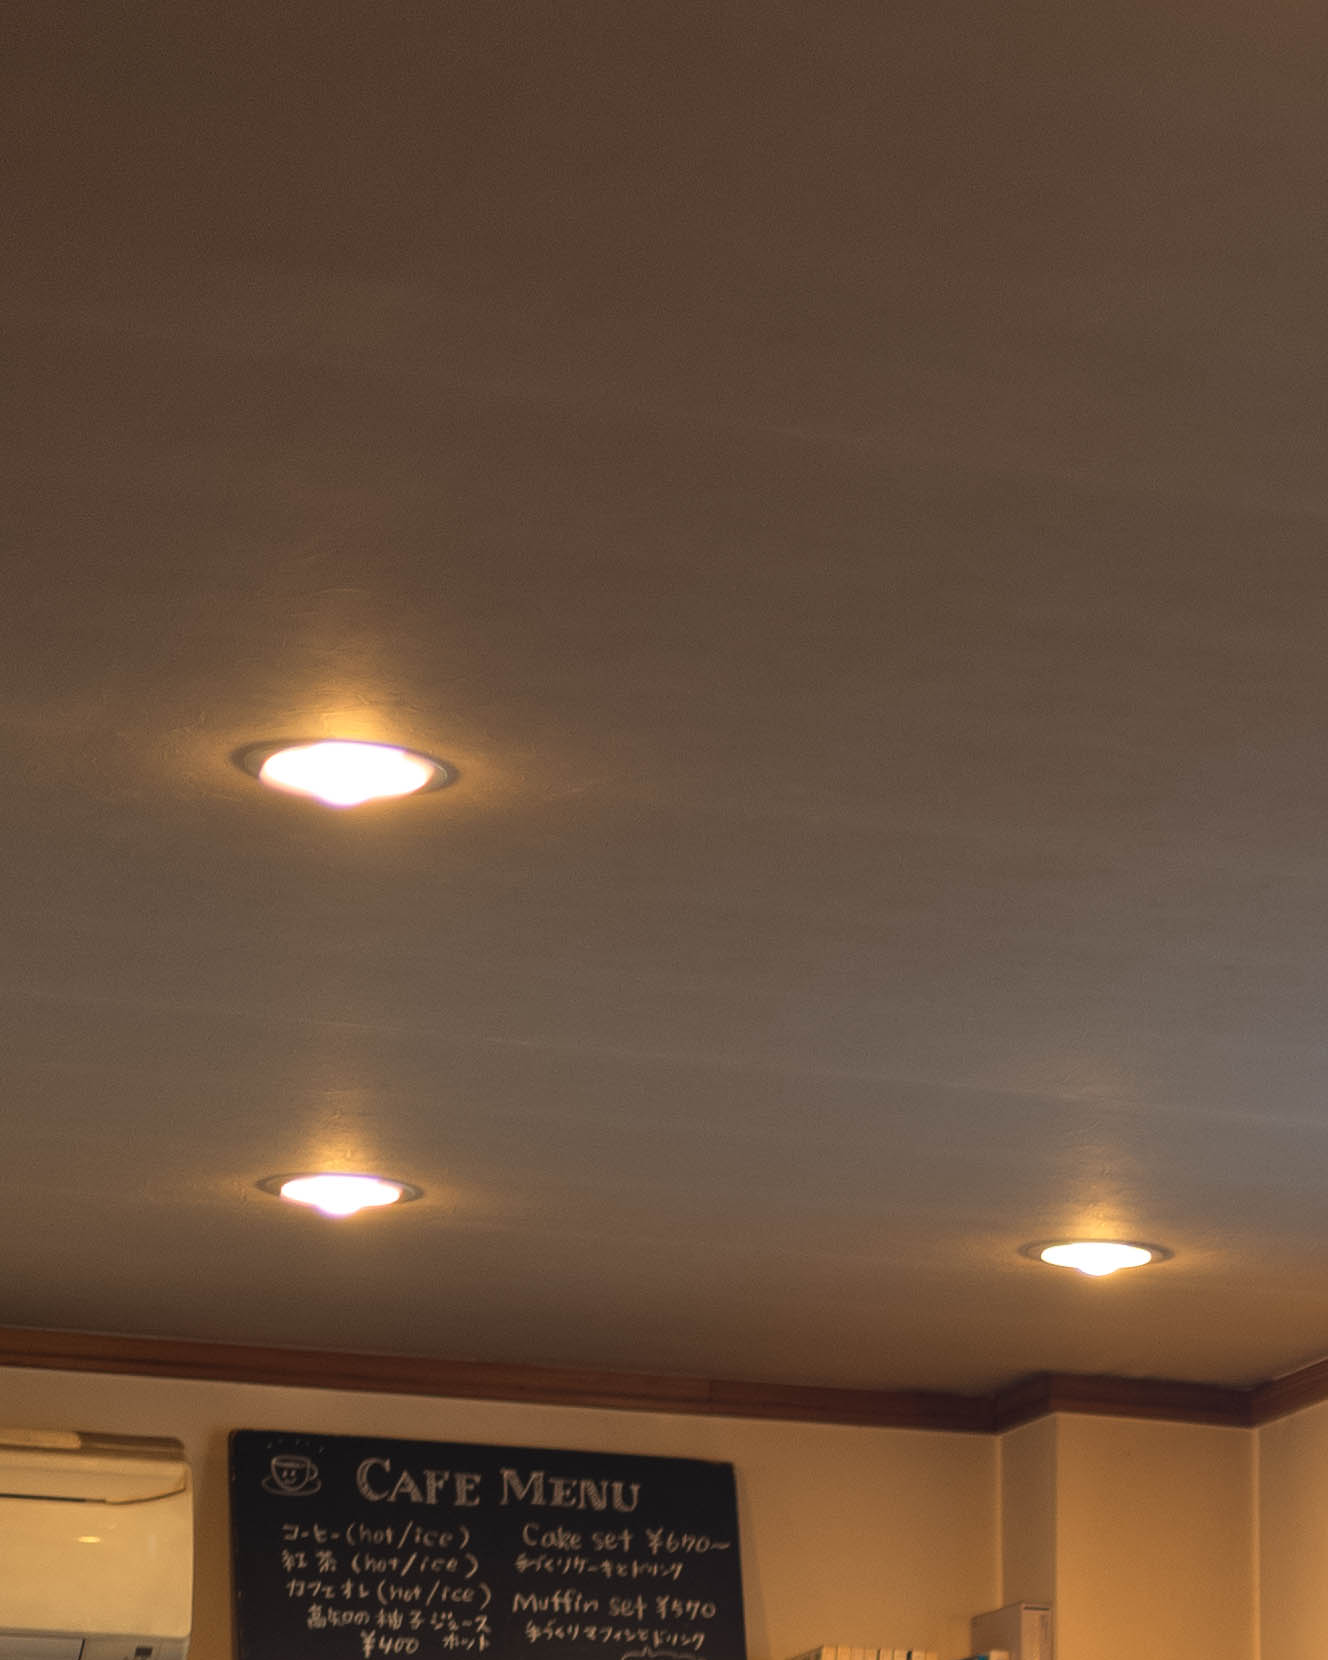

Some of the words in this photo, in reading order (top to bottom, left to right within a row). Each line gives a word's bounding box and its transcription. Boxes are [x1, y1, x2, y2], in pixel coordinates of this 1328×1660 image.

[356, 1457, 481, 1506] CAFE
[500, 1466, 641, 1512] MENU
[522, 1523, 583, 1550] Cake
[592, 1528, 633, 1552] set
[512, 1588, 600, 1614] Muffin
[609, 1595, 647, 1621] set
[360, 1629, 420, 1659] ¥400
